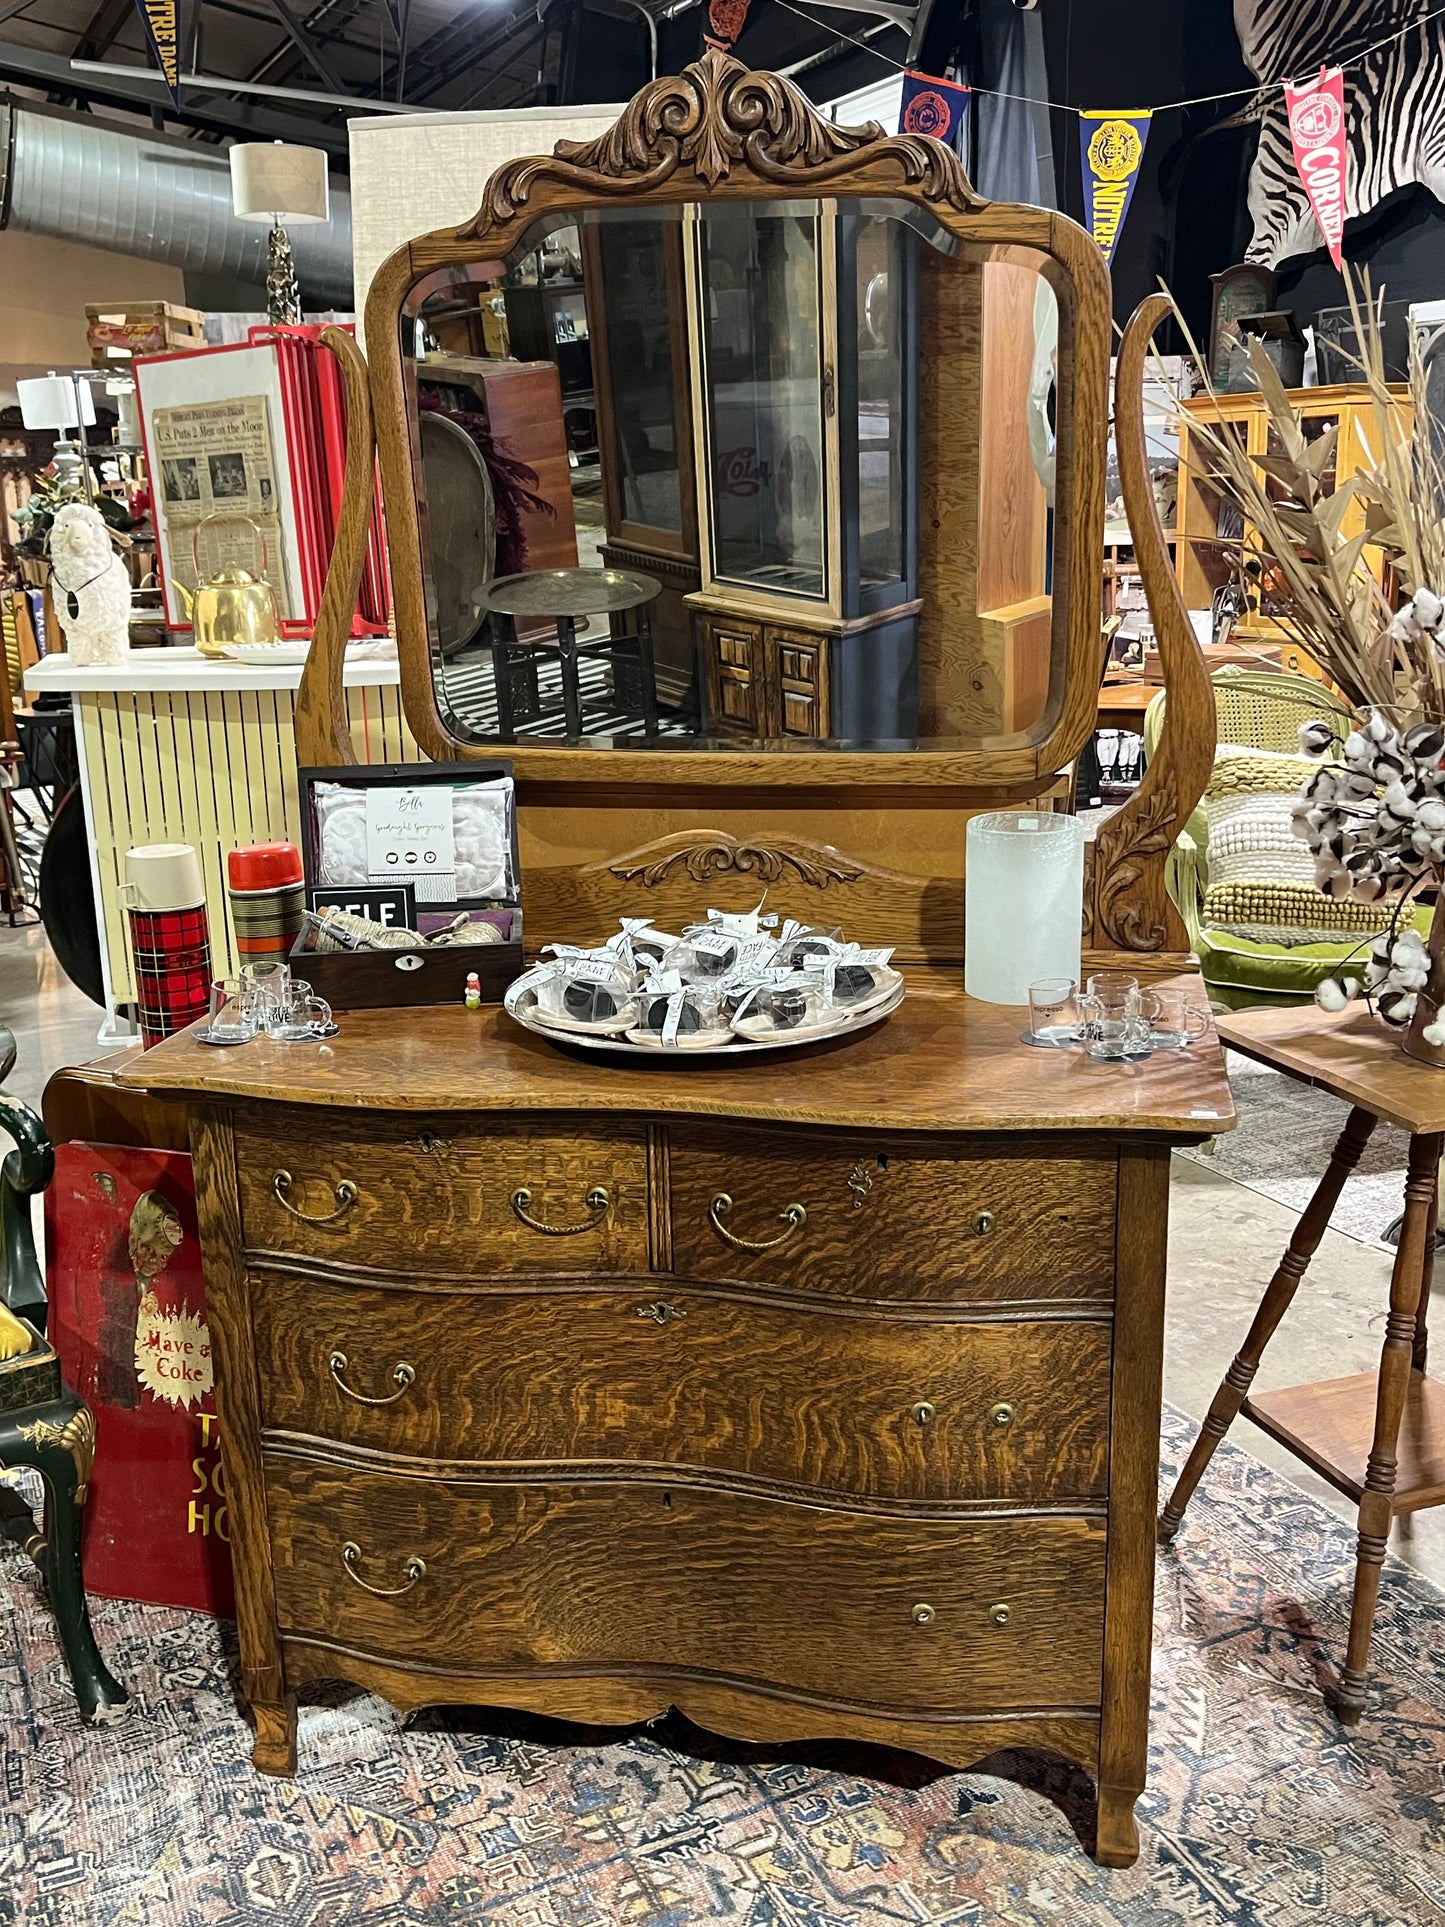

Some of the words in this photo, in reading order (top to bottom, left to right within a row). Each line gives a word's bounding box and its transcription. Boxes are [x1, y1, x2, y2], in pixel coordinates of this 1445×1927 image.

[145, 0, 176, 42] TRE
[158, 45, 177, 86] DAME
[1301, 146, 1342, 249] CORNELL
[1092, 181, 1129, 247] NOTRE
[173, 427, 191, 440] Puts
[192, 426, 198, 438] 2
[199, 424, 215, 437] Men
[216, 426, 226, 436] on
[227, 422, 240, 434] the
[242, 420, 264, 433] Moon
[395, 795, 423, 812] Bella
[375, 821, 412, 836] Goodnight
[414, 822, 446, 836] Gorgeous
[148, 1330, 194, 1351] Have
[156, 1356, 204, 1382] Coke
[195, 1412, 221, 1450] T
